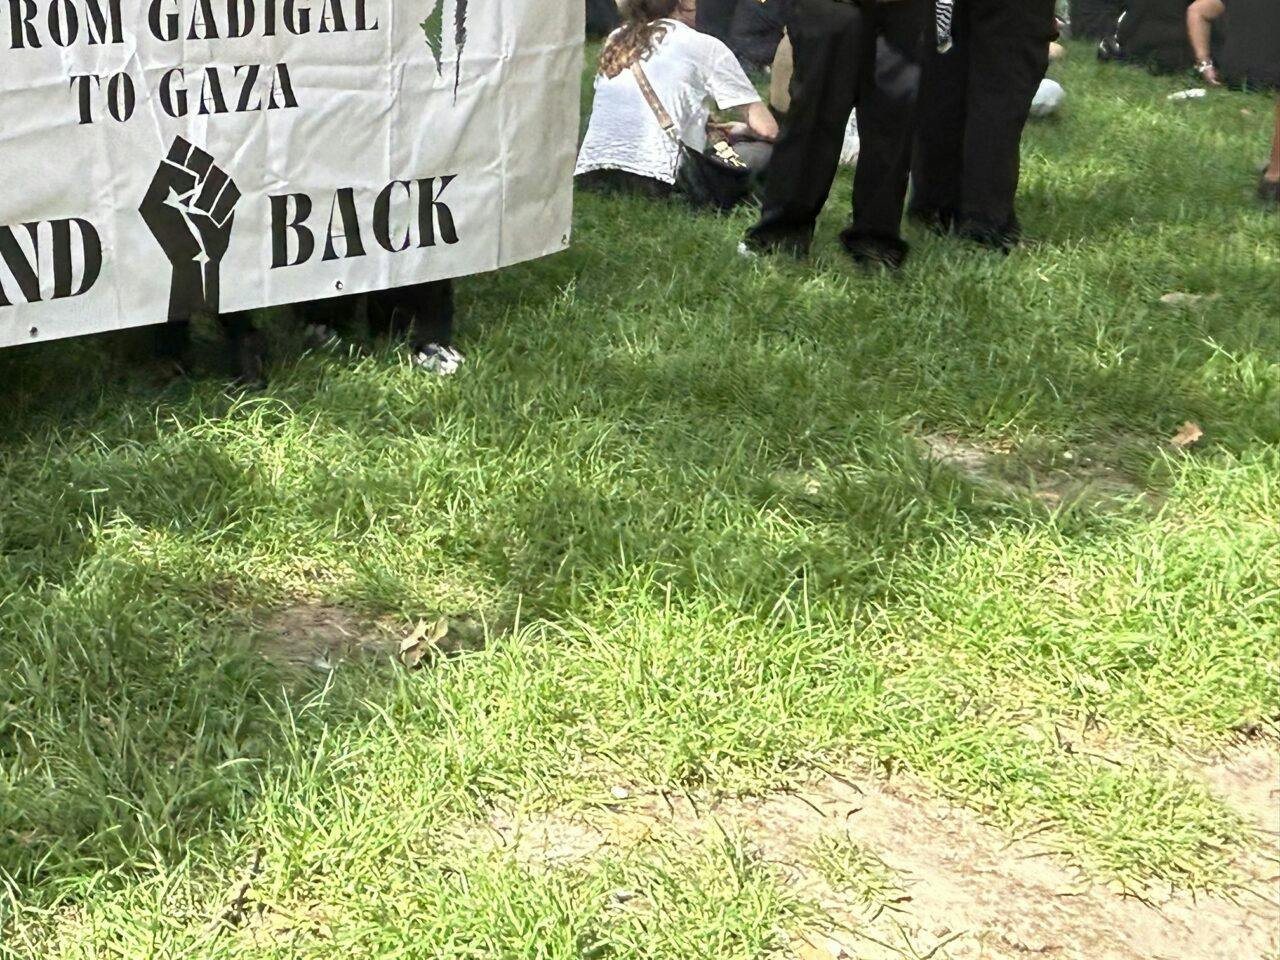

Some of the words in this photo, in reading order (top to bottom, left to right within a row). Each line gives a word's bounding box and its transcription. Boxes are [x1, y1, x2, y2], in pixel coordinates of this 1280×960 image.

[69, 71, 136, 125] TO
[158, 62, 300, 120] GAZA
[268, 173, 461, 270] BACK
